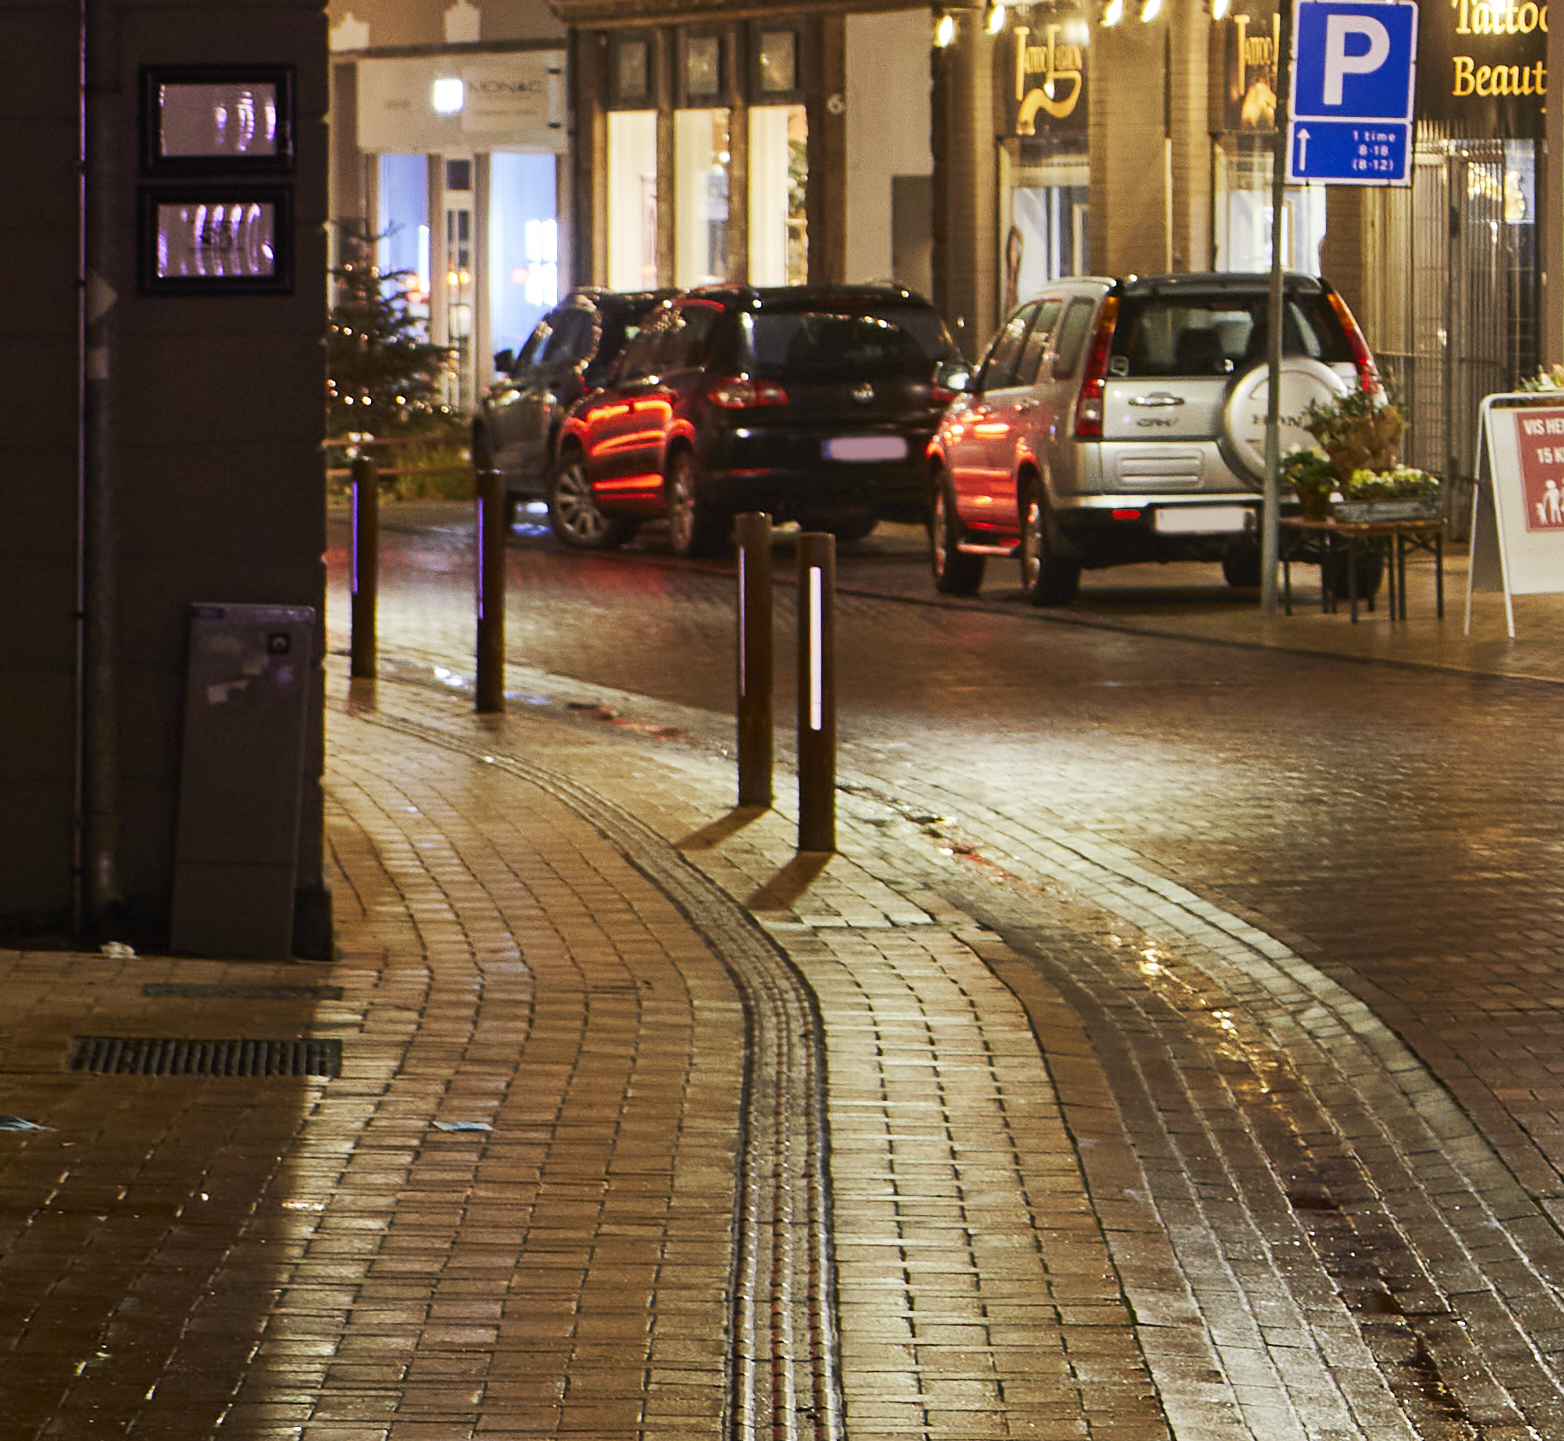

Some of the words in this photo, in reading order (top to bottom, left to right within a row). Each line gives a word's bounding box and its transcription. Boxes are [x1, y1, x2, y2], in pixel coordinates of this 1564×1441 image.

[1323, 14, 1390, 106] P
[1451, 55, 1549, 98] Beaut
[1364, 130, 1396, 143] time
[1358, 144, 1389, 156] 8-18
[1352, 158, 1394, 171] (8-12)
[1523, 419, 1546, 435] VIS
[1536, 447, 1553, 464] 15
